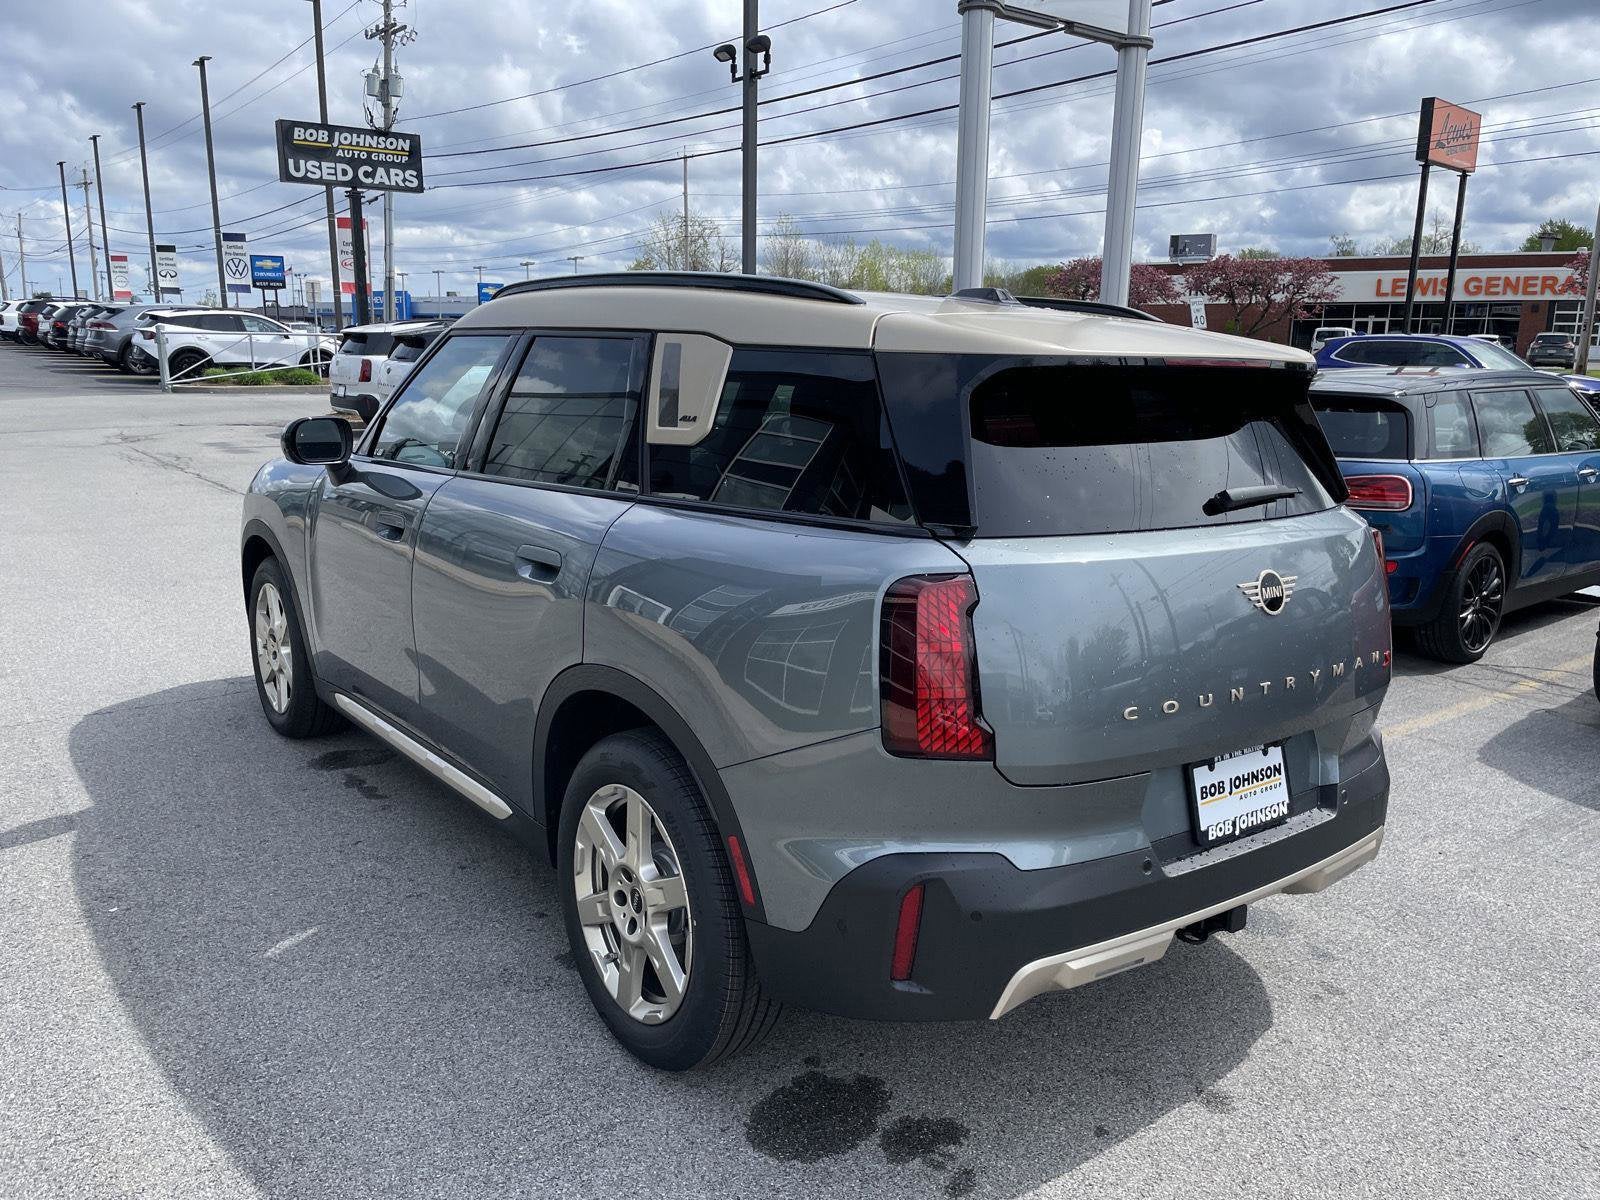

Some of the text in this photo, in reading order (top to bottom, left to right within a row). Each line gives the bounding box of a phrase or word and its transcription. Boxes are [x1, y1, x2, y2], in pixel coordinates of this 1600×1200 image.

[293, 127, 410, 151] BOB JOHNSON
[336, 149, 409, 163] AUTO GROUP
[288, 158, 419, 188] USED CARS
[1193, 315, 1206, 325] 40
[1261, 585, 1283, 599] MINI
[1123, 650, 1380, 721] COUNTRYMAN
[1200, 763, 1282, 800] BOB JOHNSON
[1239, 782, 1282, 801] AUTO GROUP
[1208, 801, 1288, 841] BOB JOHNSON
